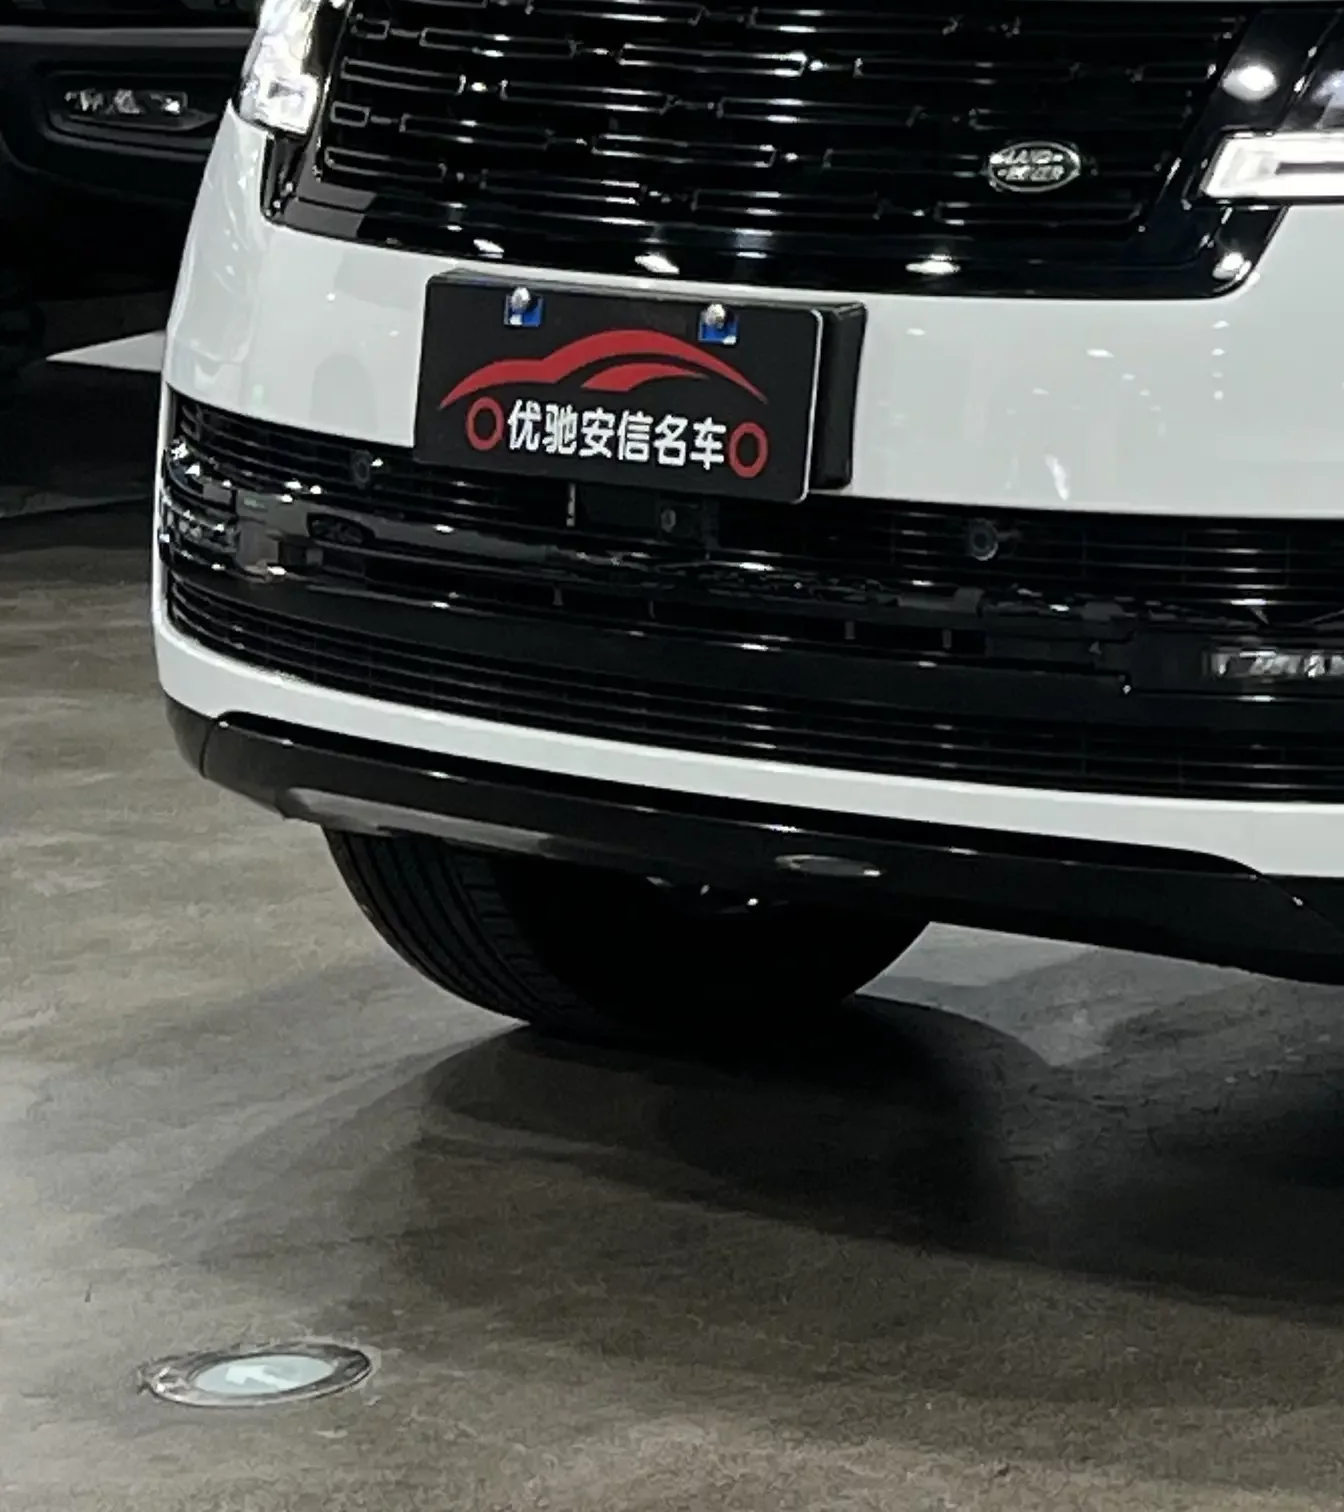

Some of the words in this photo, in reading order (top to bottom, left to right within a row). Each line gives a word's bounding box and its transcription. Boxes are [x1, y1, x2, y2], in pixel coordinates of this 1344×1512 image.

[508, 398, 728, 471] 优驰安信名车
